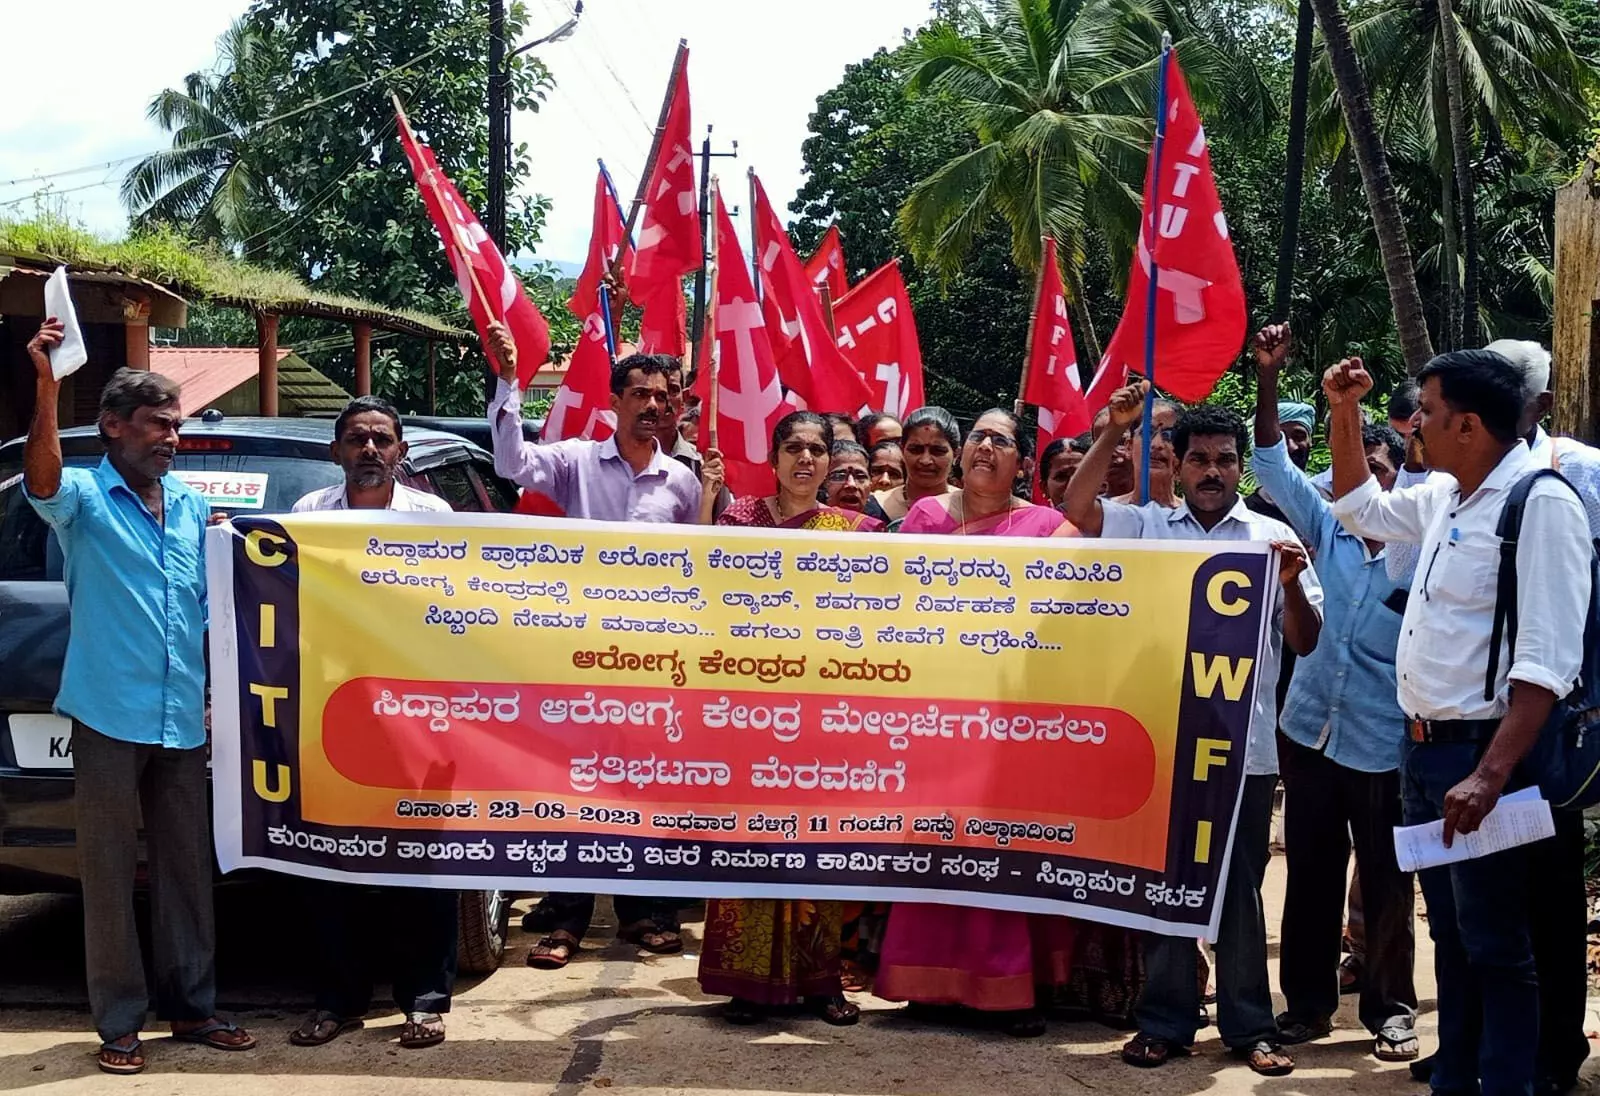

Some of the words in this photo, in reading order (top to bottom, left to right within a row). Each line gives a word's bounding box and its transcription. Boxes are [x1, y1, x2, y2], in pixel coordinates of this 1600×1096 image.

[366, 537, 467, 566] ಸಿದ್ದಾಪುರ
[482, 544, 584, 569] ಪ್ರಾಥಮಿಕ
[599, 547, 694, 577] ಆರೋಗ್ಯ
[708, 548, 782, 580] ಕೇಂದ್ರಕ್ಕೆ
[797, 553, 889, 583] ಹೆಚ್ಚುವರಿ
[904, 556, 1011, 587] ವೈದ್ಯರನ್ನು
[1025, 560, 1123, 582] ನೇಮಿಸಿರಿ
[361, 568, 455, 597] ಆರೋಗ್ಯ
[467, 576, 570, 605] ಕೇಂದ್ರದಲ್ಲಿ
[815, 591, 901, 612] ಶವಗಾರ
[915, 595, 1016, 616] ನಿರ್ವಹಣೆ
[1030, 599, 1130, 618] ಮಾಡಲು
[425, 605, 499, 634] ಸಿಬ್ಬಂದಿ
[513, 612, 587, 630] ನೇಮಕ
[730, 623, 801, 640] ಹಗಲು
[816, 625, 864, 648] ರಾತ್ರಿ
[877, 625, 945, 646] ಸೇವೆಗೆ
[245, 529, 291, 802] CITU
[572, 645, 686, 687] ಆರೋಗ್ಯ
[698, 650, 807, 683] ಕೇಂದ್ರದ
[819, 658, 911, 683] ಎದುರು
[373, 689, 520, 732] ಸಿದ್ದಾಪುರ
[540, 691, 684, 743] ಆರೋಗ್ಯ
[702, 696, 802, 742] ಕೇಂದ್ರ
[821, 701, 1107, 750] ಮೇಲ್ದರ್ಜೆಗೇರಿಸಲು
[1190, 570, 1254, 863] CWFI
[570, 751, 731, 793] ಪ್ರತಿಭಟನಾ
[751, 755, 907, 793] ಮೆರವಣಿಗೆ
[396, 799, 478, 818] ದಿನಾಂಕ:
[488, 801, 641, 826] 23-08-2023
[652, 811, 737, 831] ಬುಧವಾರ
[807, 816, 829, 833] 11
[839, 815, 903, 833] ಗಂಟೆಗೆ
[913, 813, 956, 840] ಬಸ್ಸು
[965, 815, 1075, 845] ನಿಲ್ದಾಣದಿಂದ
[268, 826, 386, 858] ಕುಂದಾಪುರ
[397, 838, 495, 860] ತಾಲೂಕು
[506, 839, 568, 873] ಕಟ್ಟಡ
[578, 841, 635, 872] ಮತ್ತು
[644, 846, 700, 866] ಇತರೆ
[711, 849, 806, 869] ನಿರ್ಮಾಣ
[816, 850, 931, 874] ಕಾರ್ಮಿಕರ
[941, 853, 1000, 882] ಸಂಘ
[1036, 861, 1136, 899] ಸಿದ್ದಾಪುರ
[1145, 881, 1206, 908] ಘಟಕ
